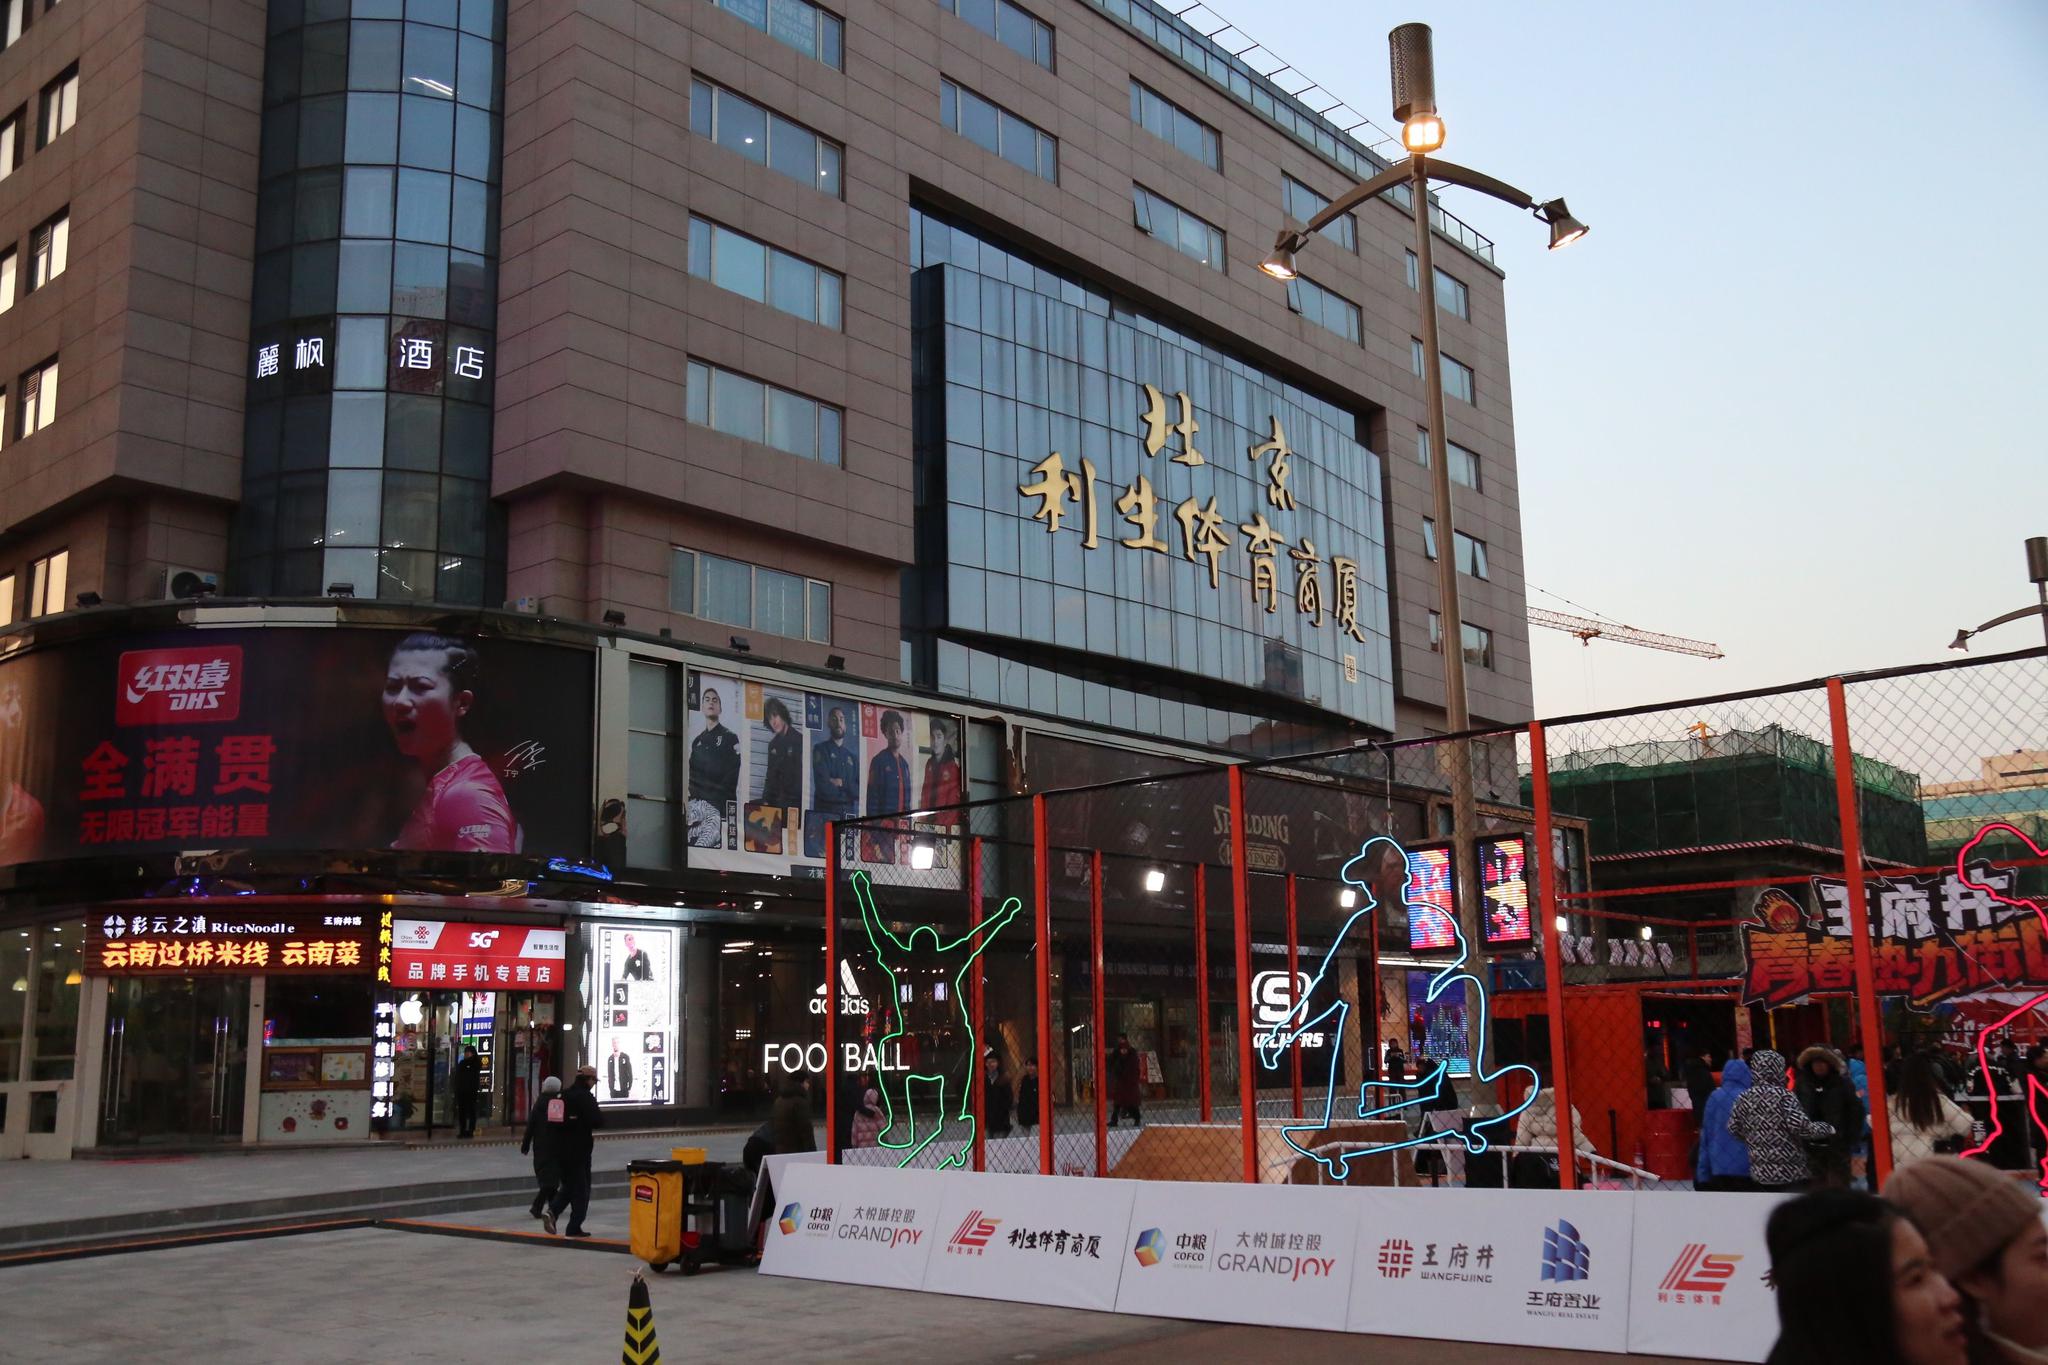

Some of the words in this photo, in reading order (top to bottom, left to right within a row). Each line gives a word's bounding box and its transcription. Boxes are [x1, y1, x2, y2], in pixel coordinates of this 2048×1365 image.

[1139, 383, 1297, 511] 北京
[1018, 451, 1366, 643] 利生体育商厦
[128, 659, 230, 697] 红双喜
[169, 691, 226, 711] DHS
[80, 735, 277, 801] 全满贯
[80, 804, 270, 844] 无限冠军能量
[1213, 804, 1289, 844] SPLDING
[1820, 868, 2010, 938] 王府井
[132, 916, 207, 935] 彩云之滇
[211, 921, 295, 934] RiceNoodle
[378, 911, 393, 983] 过桥米线
[469, 931, 497, 948] 5G
[101, 940, 270, 968] 云南过桥米线
[281, 940, 361, 967] 云南菜
[408, 962, 551, 983] 品牌手机专营店
[809, 995, 870, 1015] adas
[764, 1042, 910, 1073] FOOBALL
[807, 1222, 830, 1231] COFCO
[809, 1207, 833, 1223] 中粮
[853, 1206, 916, 1223] 大悦城控股
[838, 1224, 923, 1248] GRANDJOY
[1007, 1228, 1102, 1258] 利生体育商厦
[1176, 1233, 1207, 1250] 中粮
[1236, 1231, 1321, 1251] 大悦城控股
[1174, 1251, 1204, 1262] COFCO
[1217, 1253, 1335, 1281] GRANDJOY
[1422, 1243, 1494, 1269] 王府井
[1421, 1271, 1493, 1283] WANGFUJING
[1526, 1291, 1600, 1310] 王府置业
